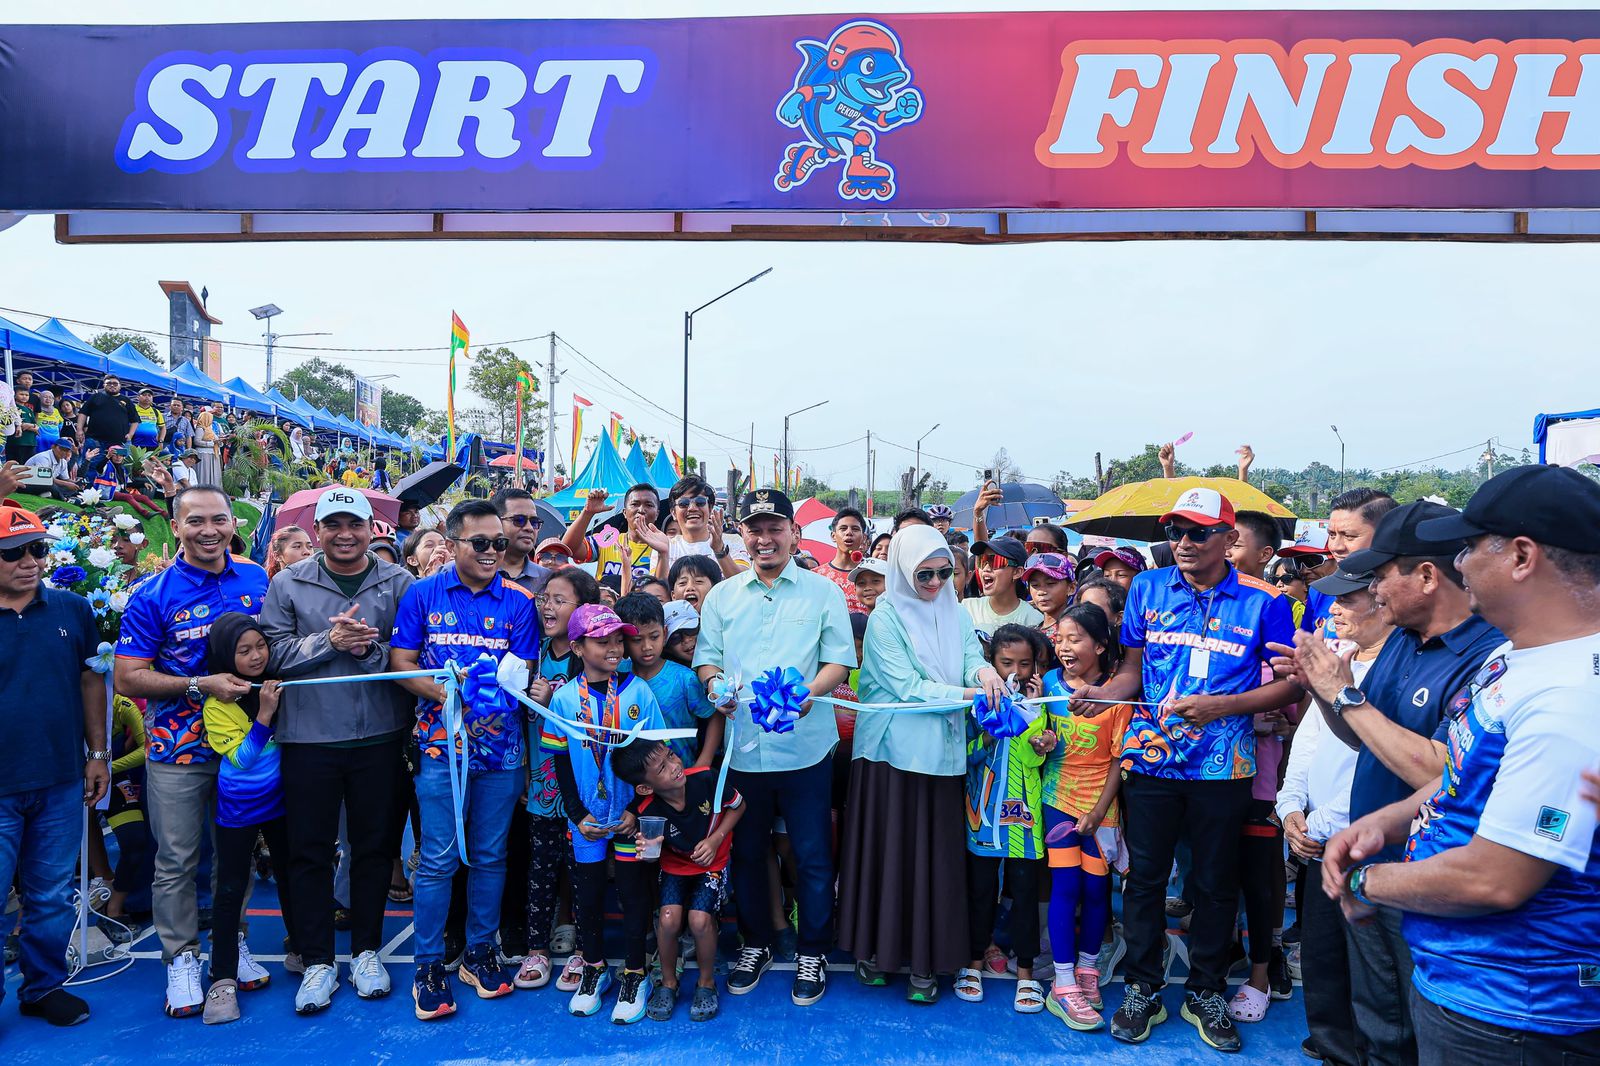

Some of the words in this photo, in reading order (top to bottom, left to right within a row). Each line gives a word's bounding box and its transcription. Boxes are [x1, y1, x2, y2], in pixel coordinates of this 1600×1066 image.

[127, 59, 645, 161] START
[836, 103, 862, 120] PEKOPI
[1048, 51, 1600, 156] FINISH
[328, 491, 355, 504] JED
[9, 523, 37, 533] Reebok
[1146, 630, 1247, 658] EKANBARU
